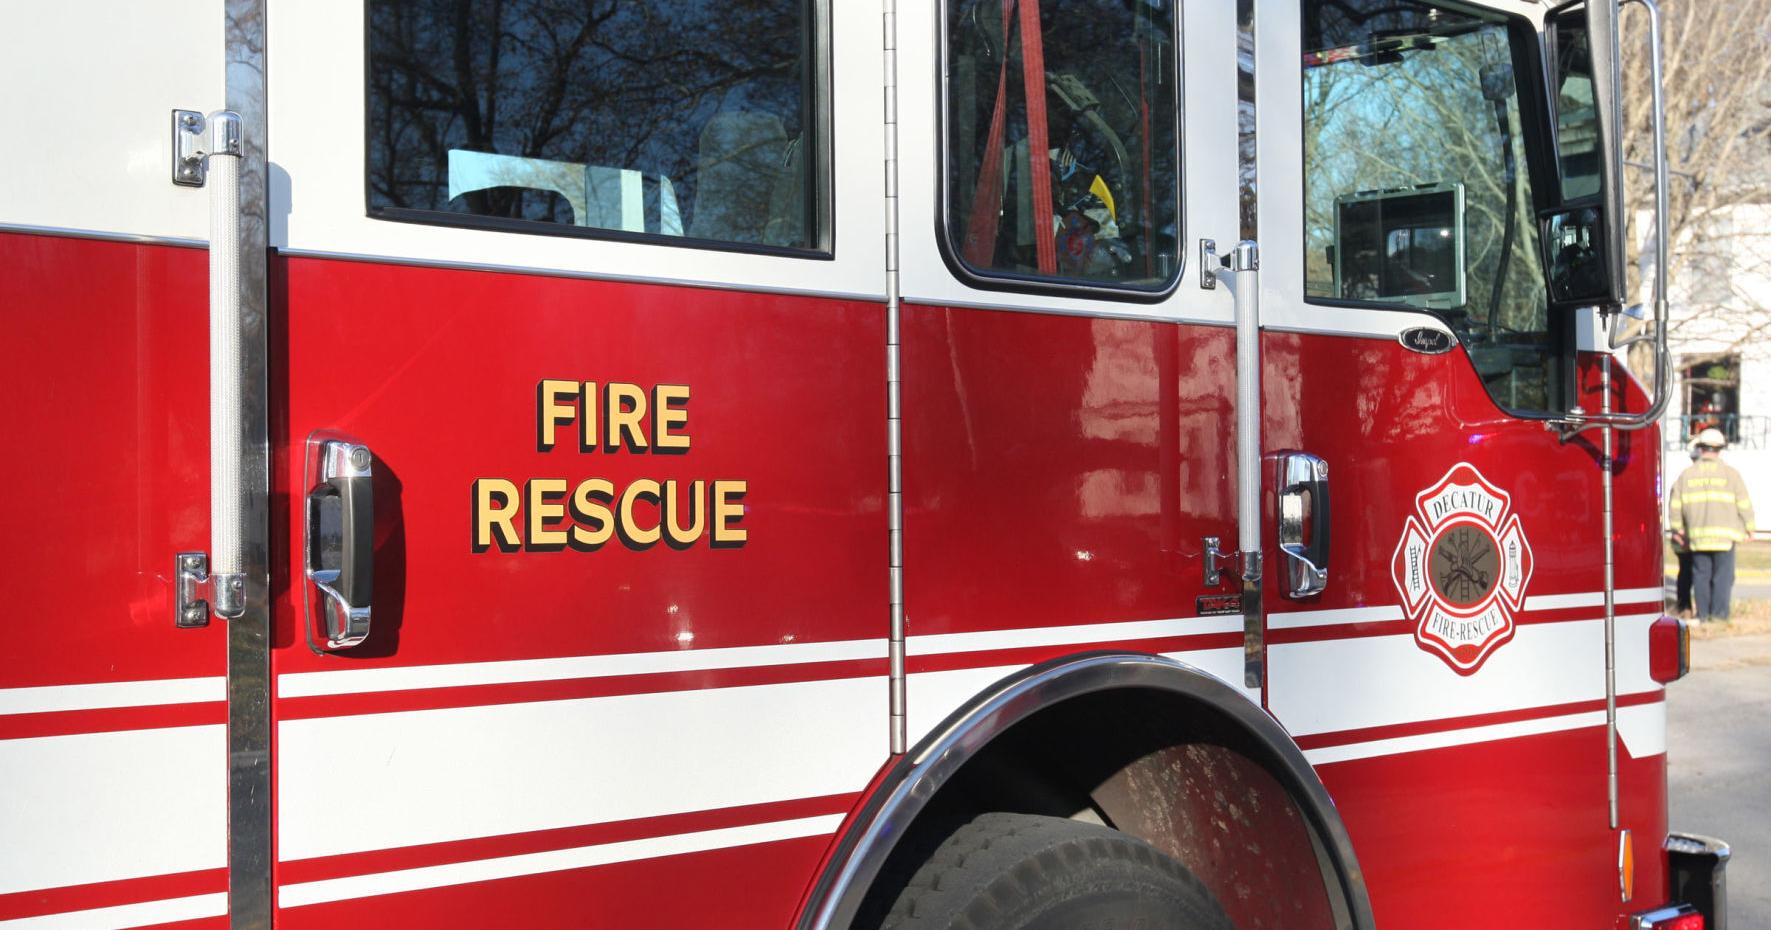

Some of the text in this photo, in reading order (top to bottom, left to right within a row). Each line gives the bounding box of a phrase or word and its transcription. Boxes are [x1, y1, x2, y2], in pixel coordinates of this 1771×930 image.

[536, 379, 691, 455] FIRE
[472, 478, 747, 553] RESCUE
[1433, 491, 1494, 520] DECATUR
